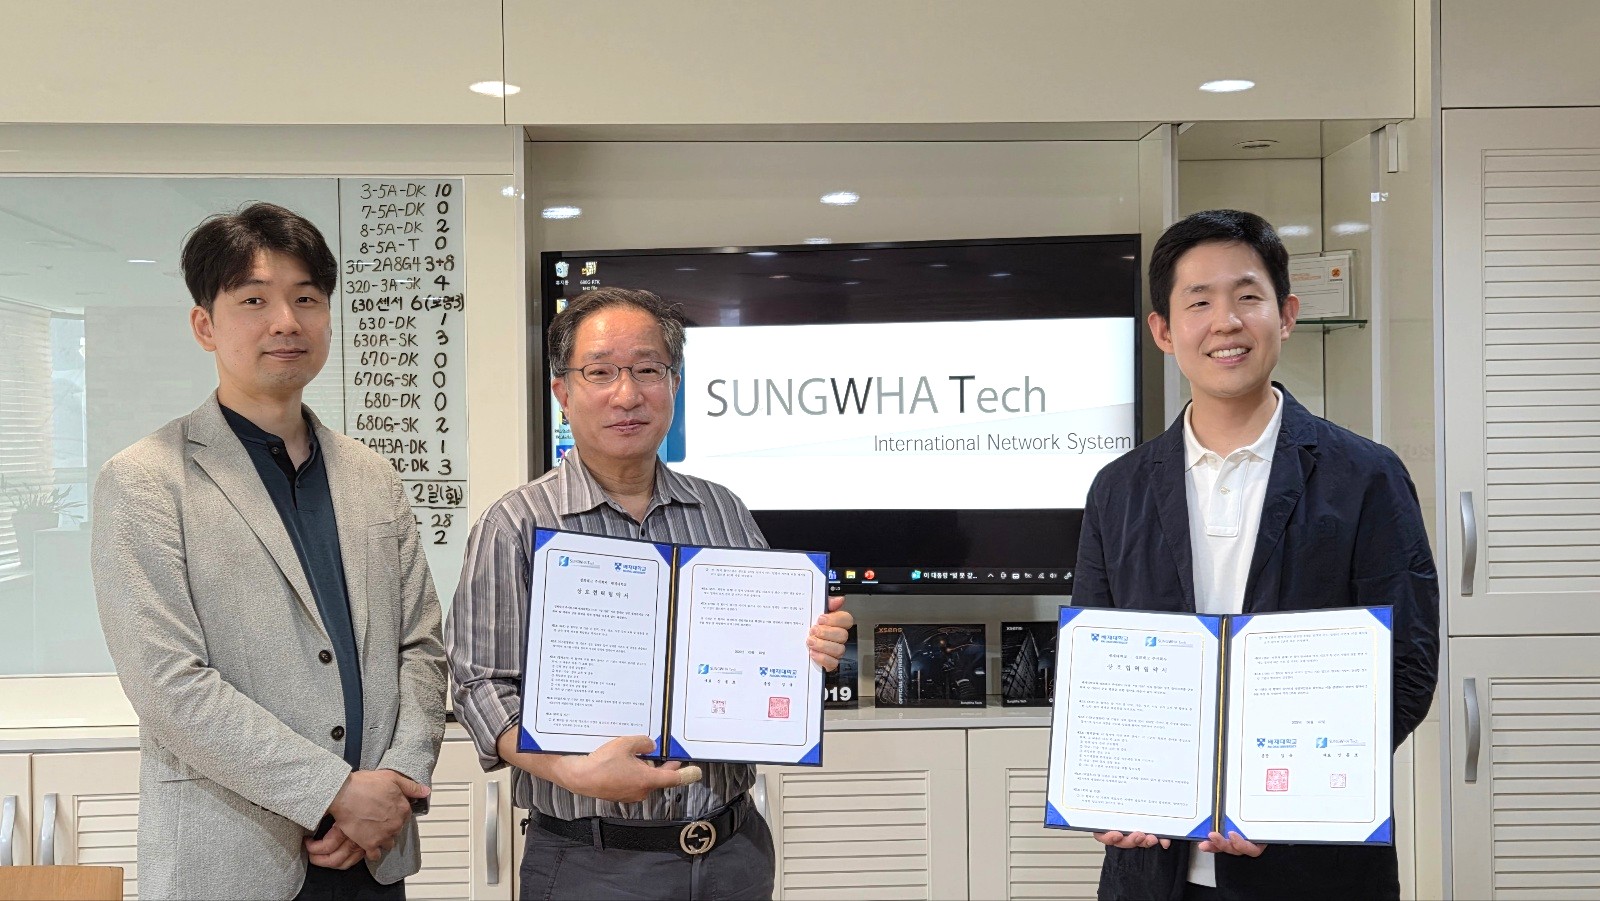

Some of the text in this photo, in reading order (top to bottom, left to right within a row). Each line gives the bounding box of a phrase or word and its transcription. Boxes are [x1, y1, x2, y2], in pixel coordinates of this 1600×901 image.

[360, 183, 452, 200] 3-5A-DK 10
[361, 200, 449, 219] 7-5A-DK 0
[360, 218, 450, 237] 8-5A-DK 2
[360, 236, 447, 254] 8-5A-T 0
[424, 254, 455, 272] 3+8
[434, 274, 450, 291] 4
[359, 313, 448, 331] 630-DK 1
[435, 330, 449, 345] 3
[360, 351, 447, 368] 670-DK 0
[354, 371, 446, 388] 670G-SK 0
[364, 391, 447, 411] 680-DK 0
[707, 375, 1046, 417] SUNGWHA Tech
[356, 413, 450, 433] 680G-SK 2
[441, 439, 445, 454] 1
[874, 432, 1132, 455] International Network System
[438, 459, 452, 475] 3
[431, 514, 454, 528] 28
[434, 530, 448, 544] 2
